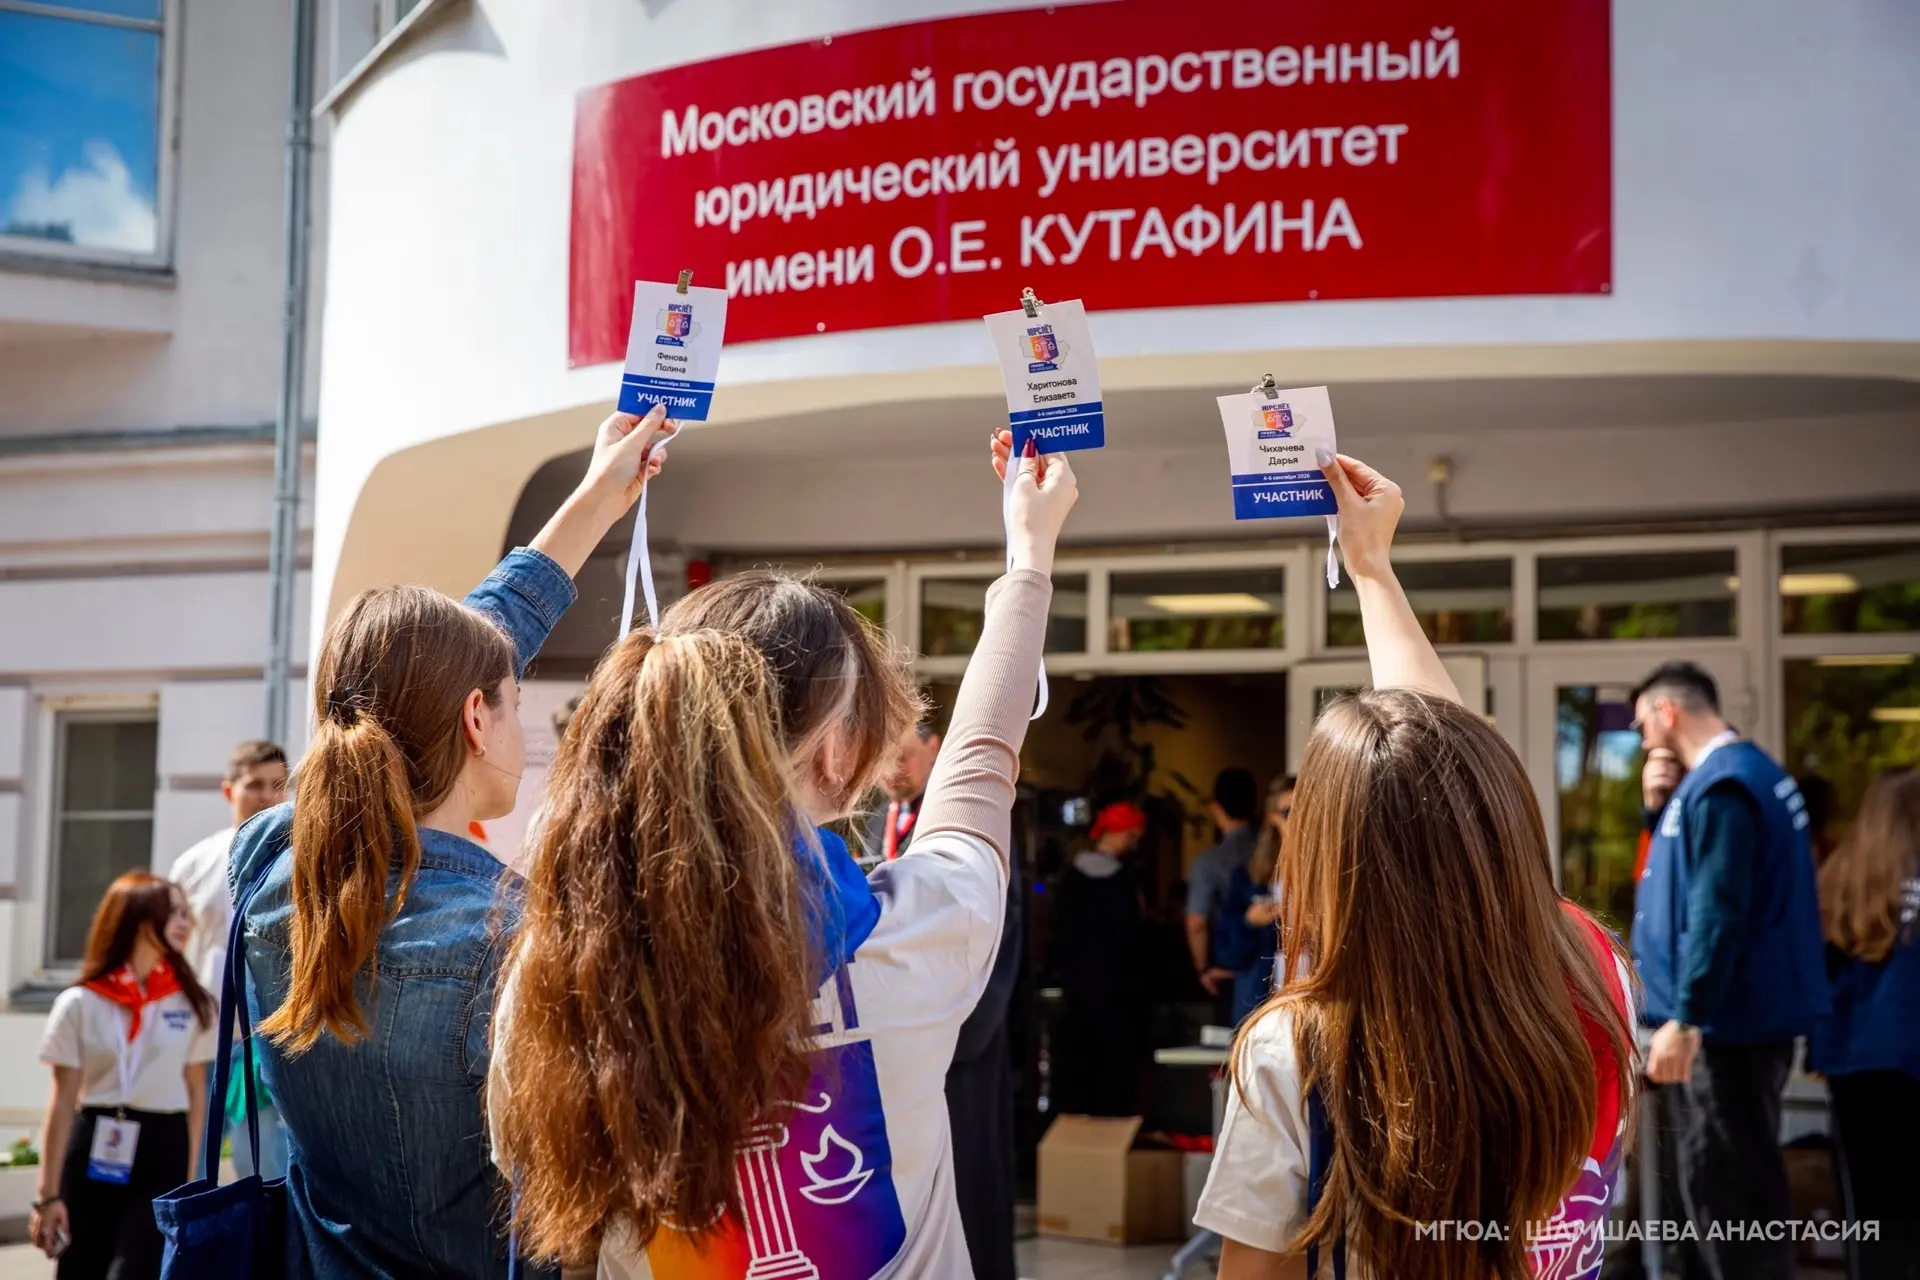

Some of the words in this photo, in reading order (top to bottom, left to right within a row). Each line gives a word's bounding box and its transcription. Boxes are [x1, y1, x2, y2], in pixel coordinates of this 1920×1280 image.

[660, 66, 937, 159] Московский
[952, 26, 1460, 118] государственный
[694, 137, 1021, 234] юридический
[1036, 122, 1409, 198] университет
[726, 243, 875, 299] имени
[889, 220, 1003, 279] О.Е.
[1019, 197, 1364, 268] КУТАФИНА
[657, 352, 688, 363] Фенова
[655, 363, 686, 374] Полина
[1027, 377, 1077, 391] Харитонова
[637, 392, 697, 408] УЧАСТНИК
[1033, 391, 1076, 404] Елизавета
[1029, 423, 1090, 440] УЧАСТНИК
[1259, 444, 1305, 453] Чихачева
[1268, 456, 1299, 467] Дарья
[1253, 489, 1324, 504] УЧАСТНИК
